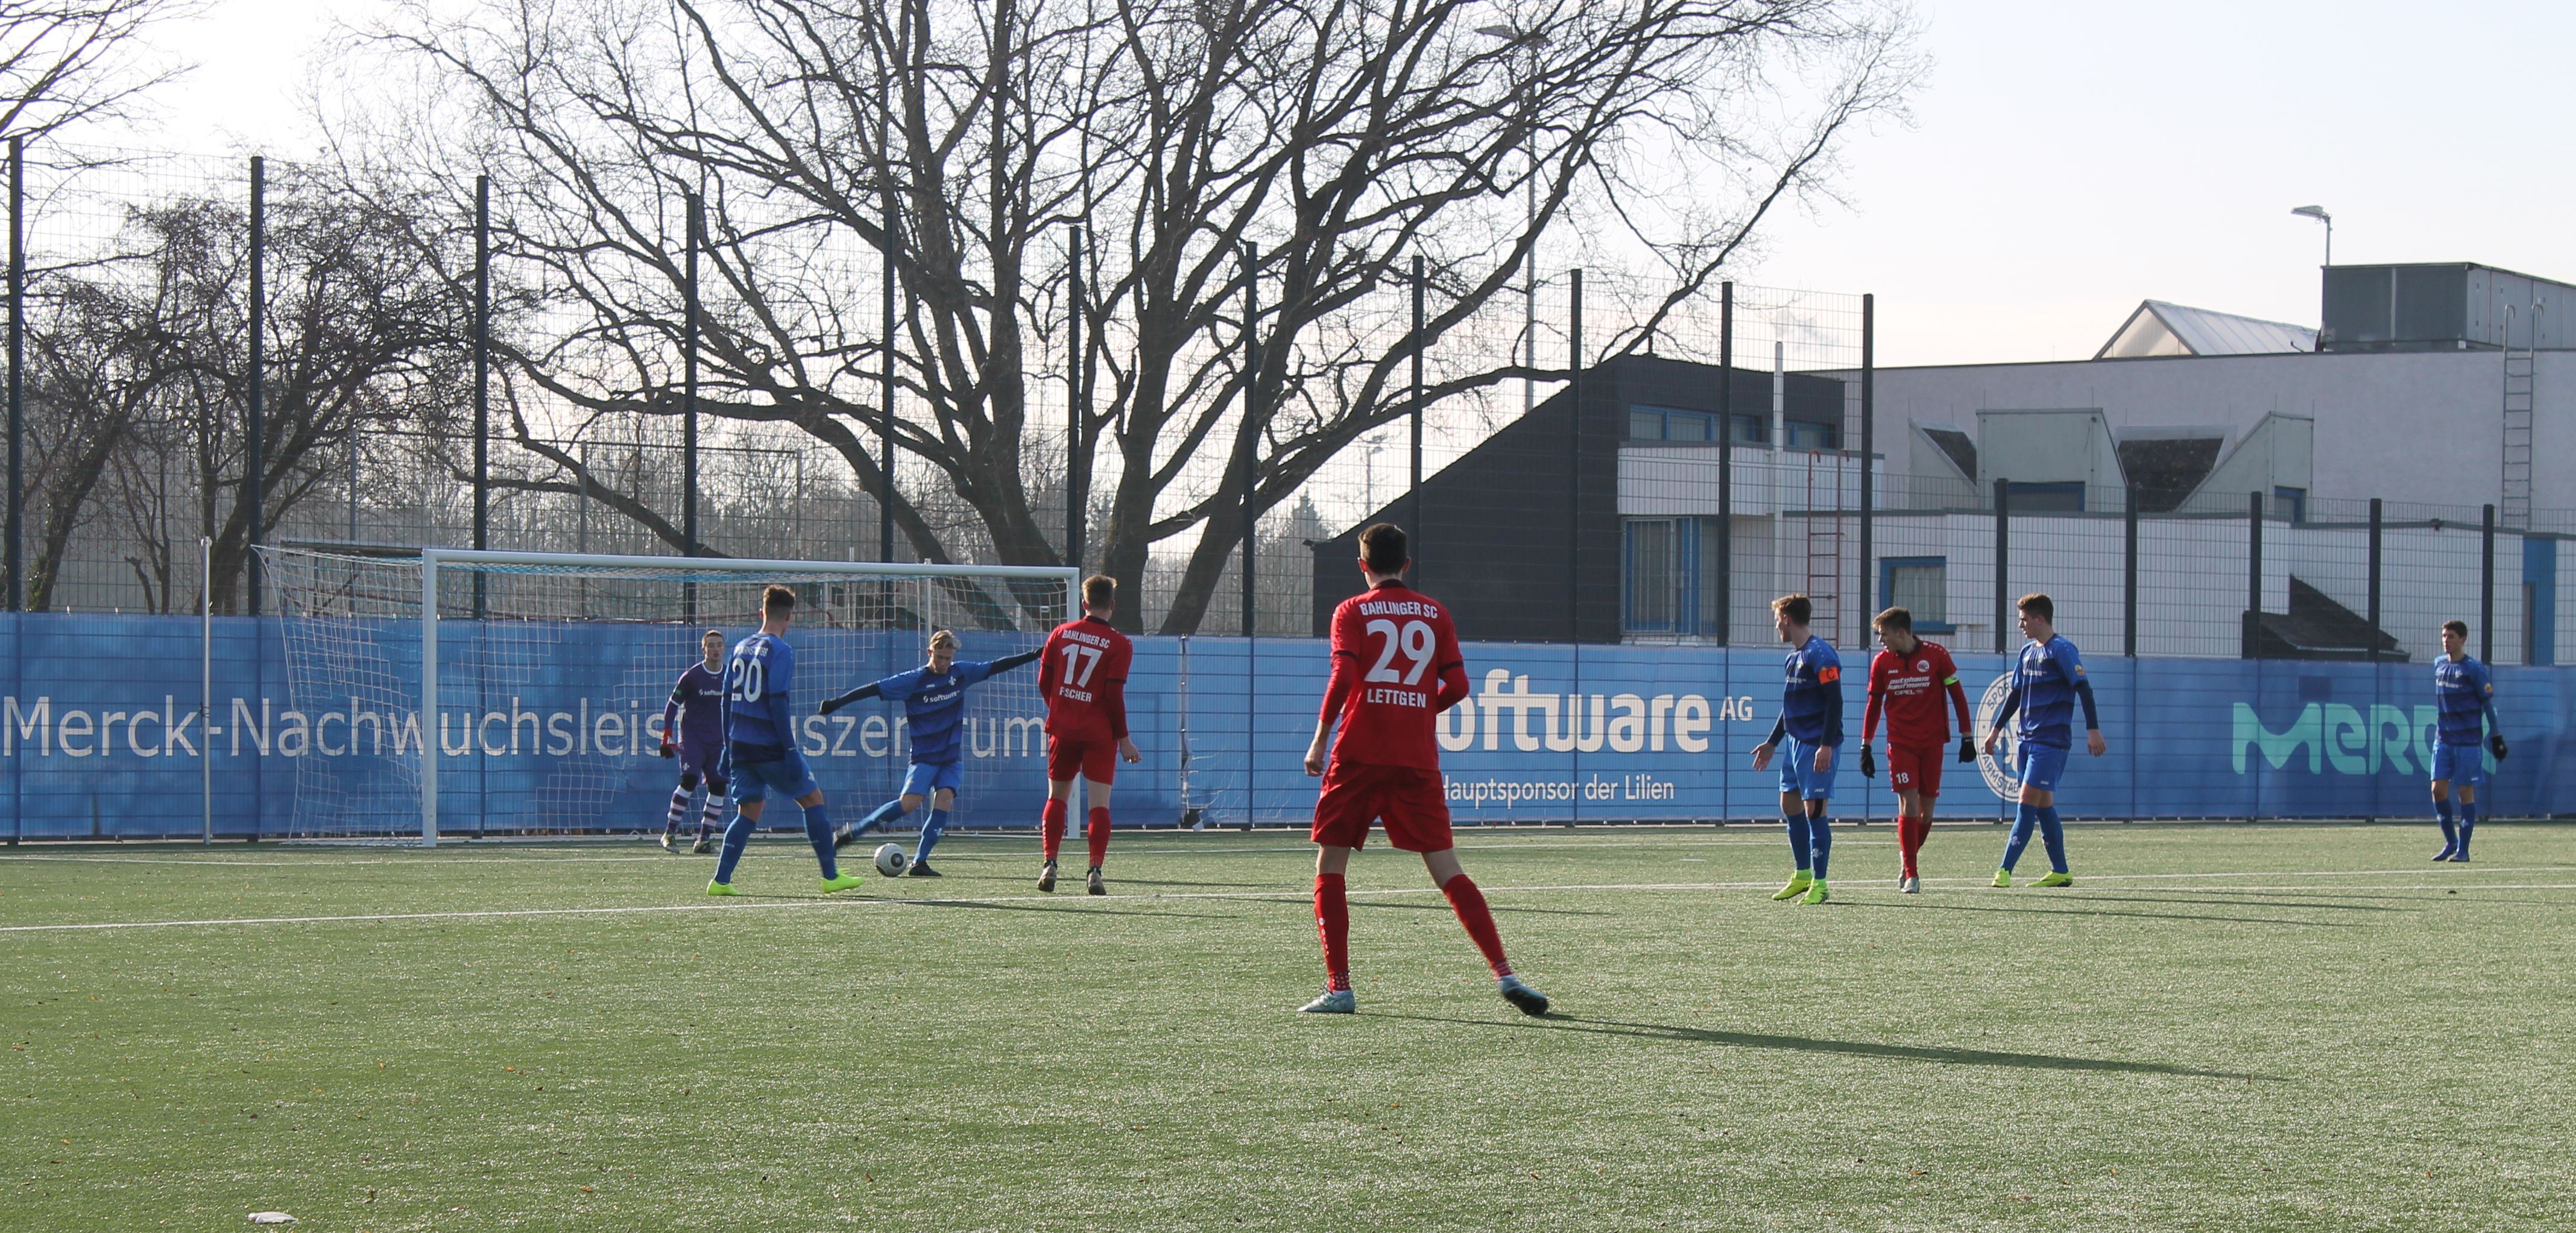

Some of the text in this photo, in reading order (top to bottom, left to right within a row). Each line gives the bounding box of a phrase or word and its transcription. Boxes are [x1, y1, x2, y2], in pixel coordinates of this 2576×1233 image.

[1360, 601, 1438, 618] BAHLINGER SC
[1062, 629, 1110, 649] BAHLINGER SC
[1364, 619, 1435, 685] 29
[1062, 644, 1103, 688] 17
[1827, 668, 1836, 679] C
[732, 658, 762, 703] 20
[1367, 688, 1426, 708] LETTGEN
[1987, 682, 2010, 710] SPOR
[1436, 668, 1753, 752] oftware AG
[1585, 773, 1618, 800] der
[1625, 774, 1674, 800] Lilien
[1896, 773, 1909, 784] 18
